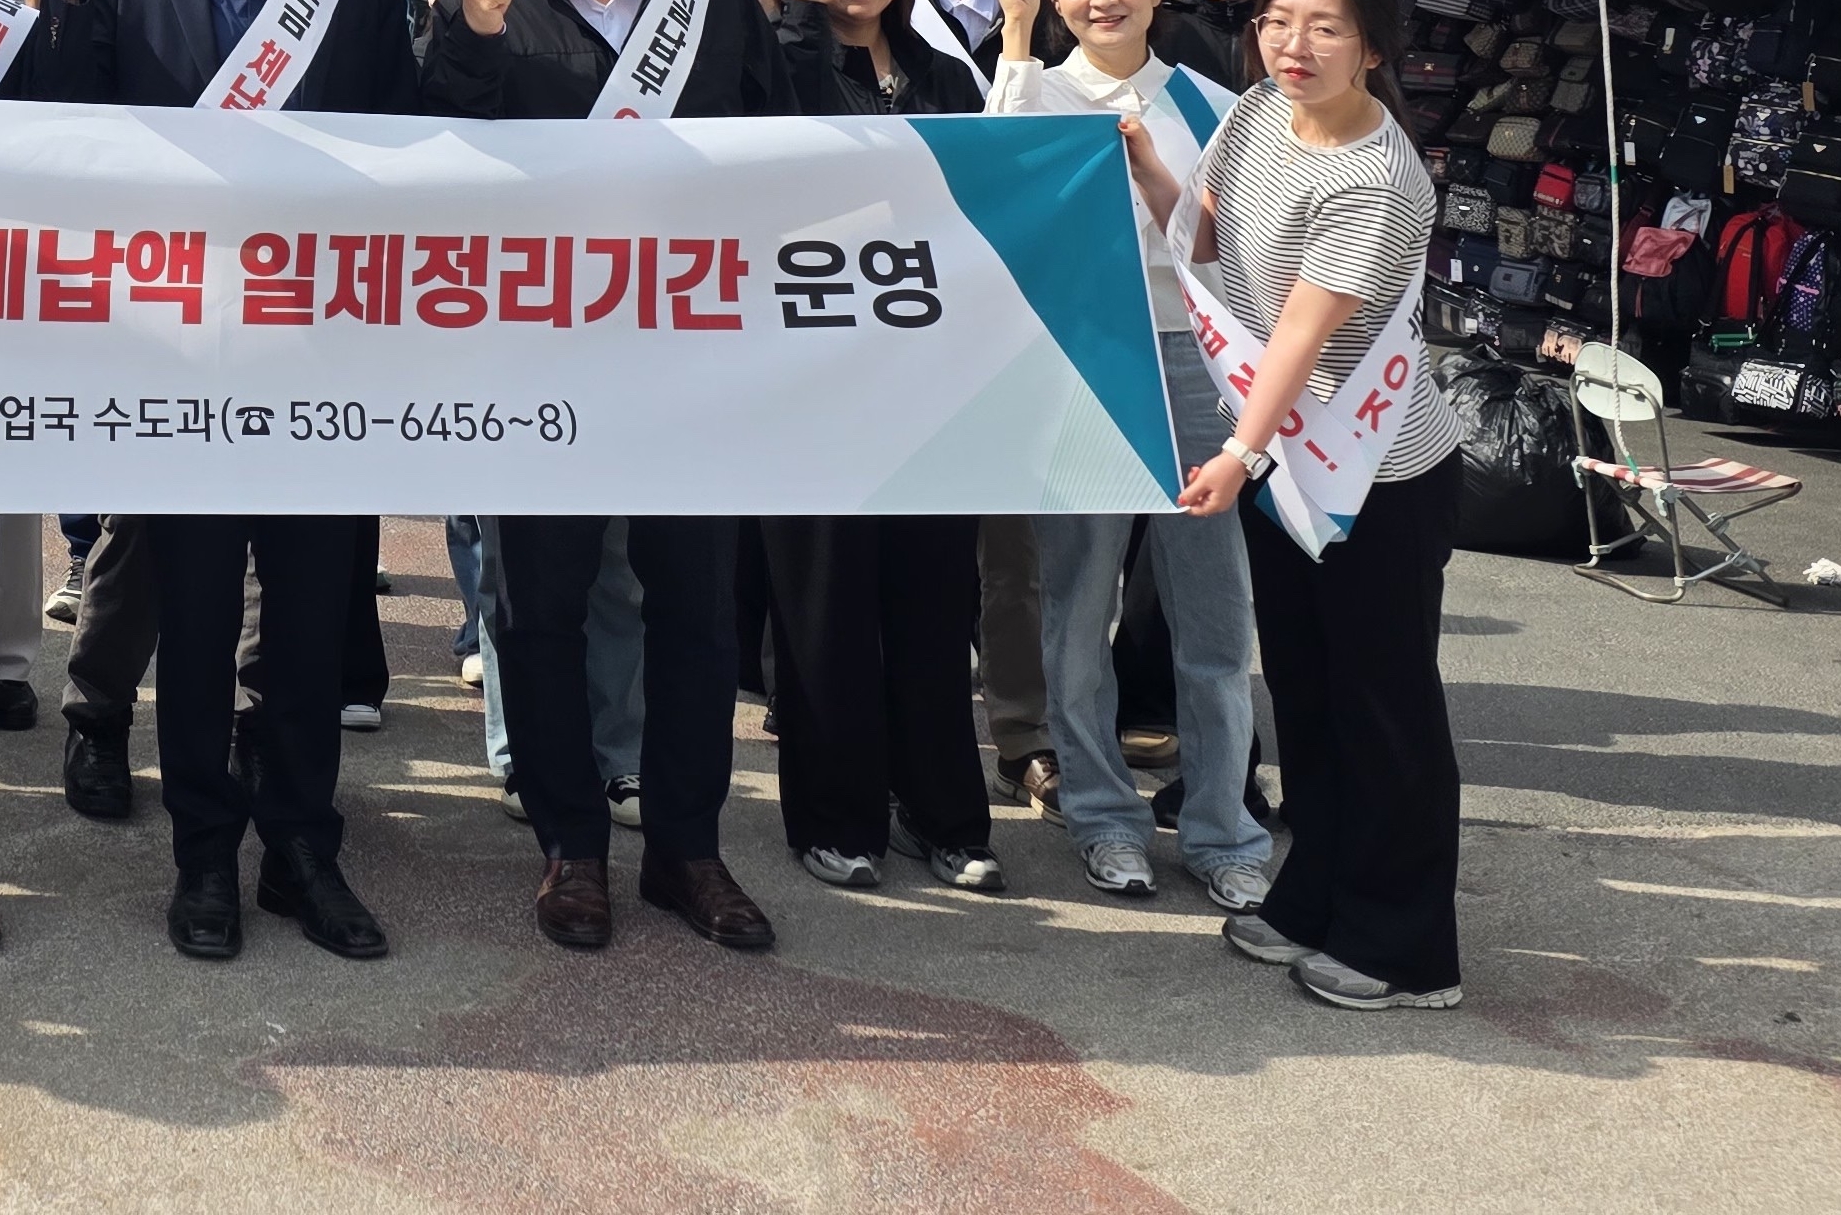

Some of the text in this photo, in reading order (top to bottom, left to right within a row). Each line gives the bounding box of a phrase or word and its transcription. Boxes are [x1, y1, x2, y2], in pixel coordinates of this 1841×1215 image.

[241, 231, 748, 331] 일제정리기간
[773, 238, 944, 331] 운영
[289, 399, 578, 446] 530-6456~8)
